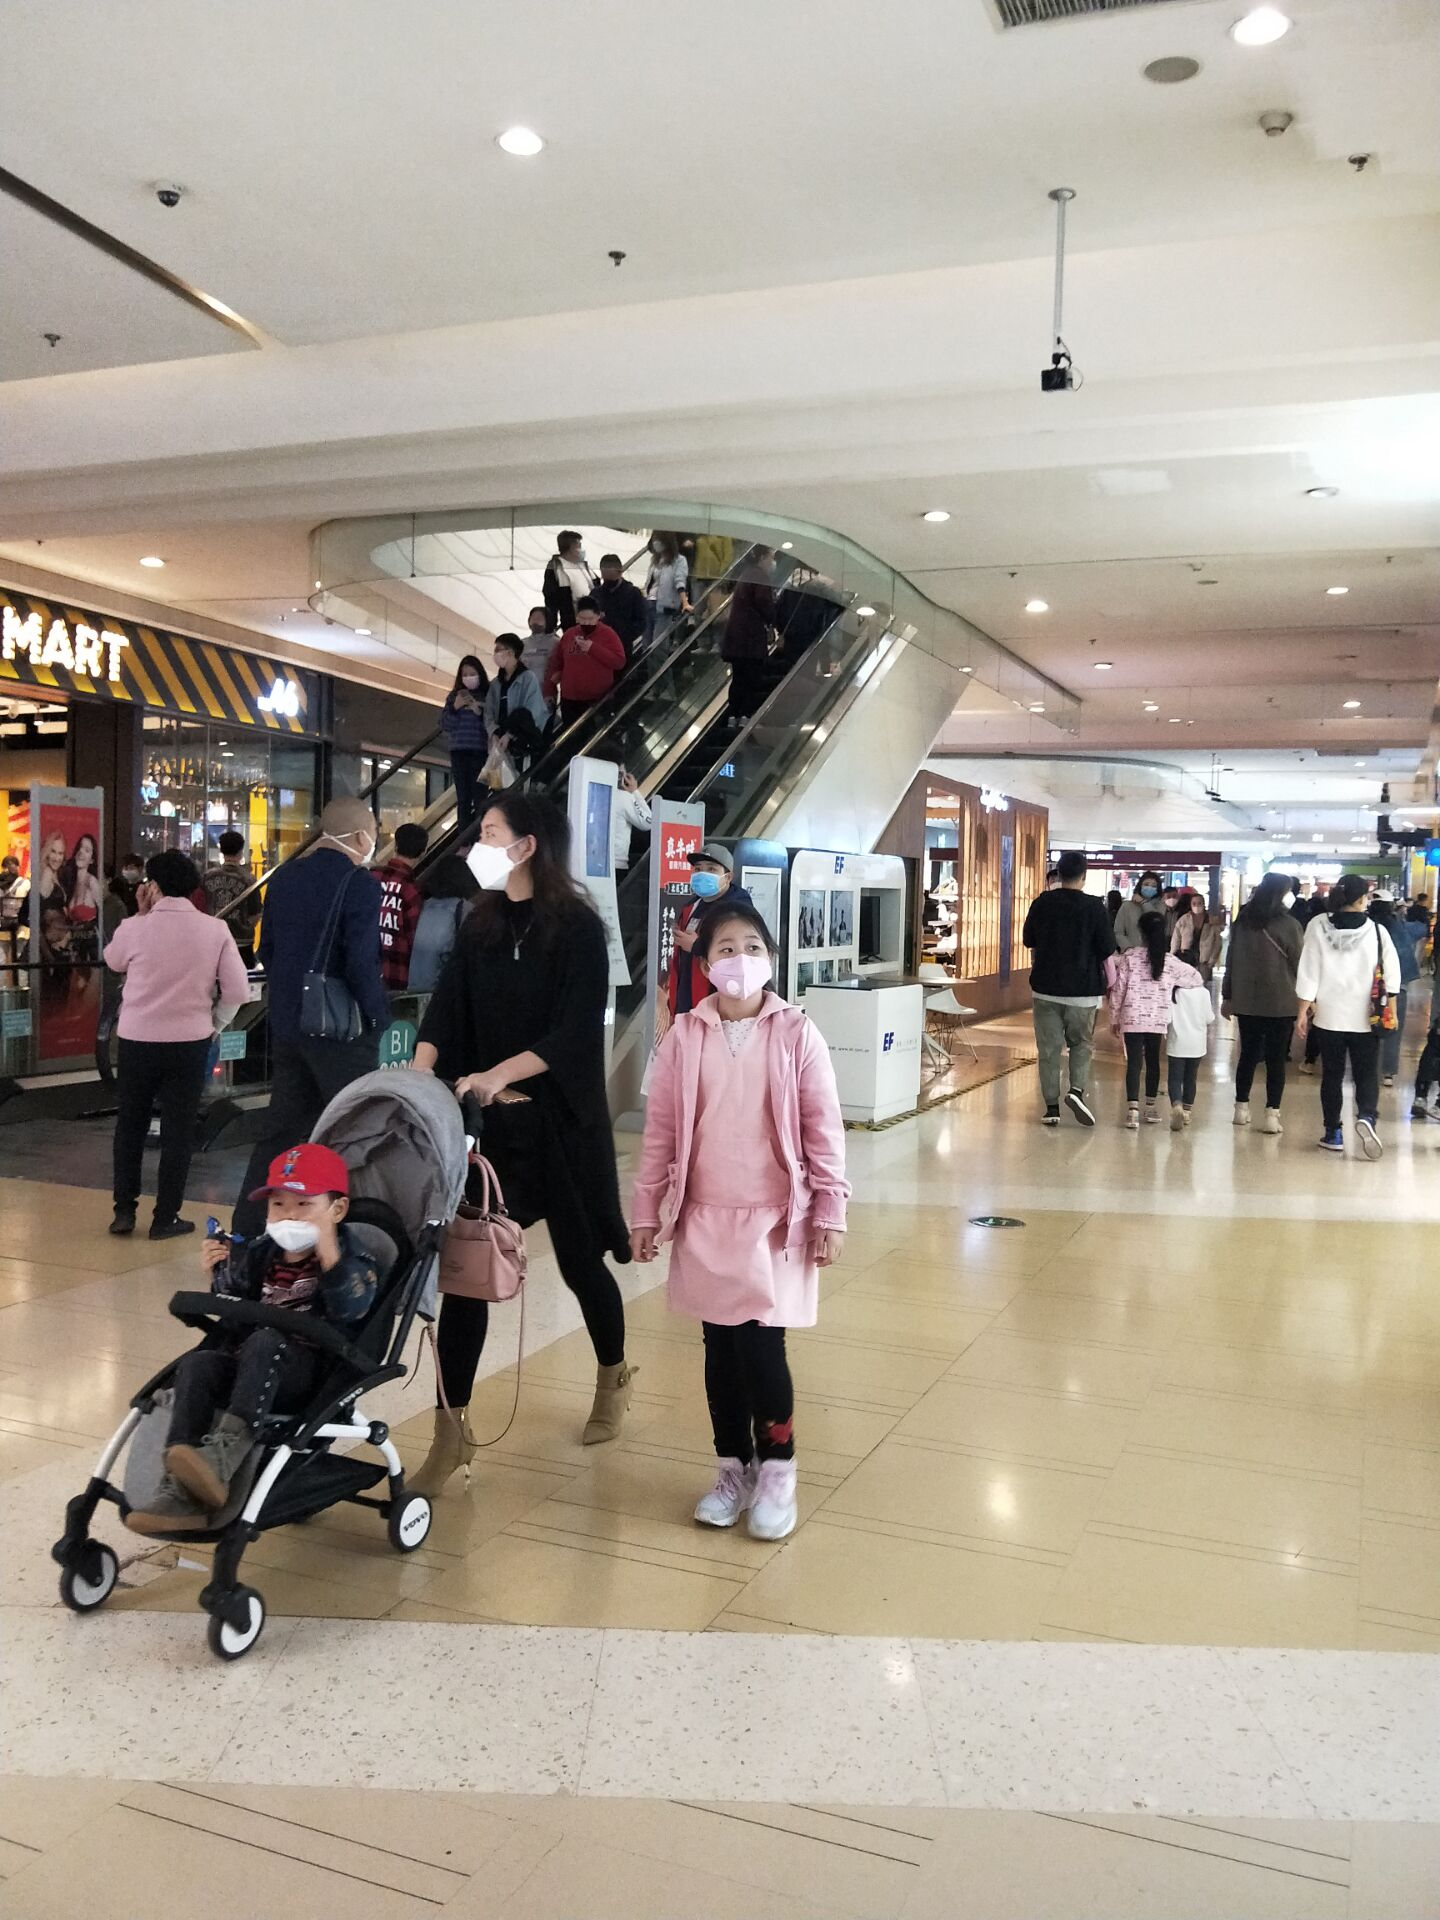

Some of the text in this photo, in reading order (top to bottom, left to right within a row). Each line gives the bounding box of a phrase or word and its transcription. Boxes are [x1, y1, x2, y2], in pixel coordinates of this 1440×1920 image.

[2, 606, 130, 682] MART
[834, 855, 845, 875] EF
[380, 881, 402, 893] NTI
[882, 1031, 895, 1052] EF
